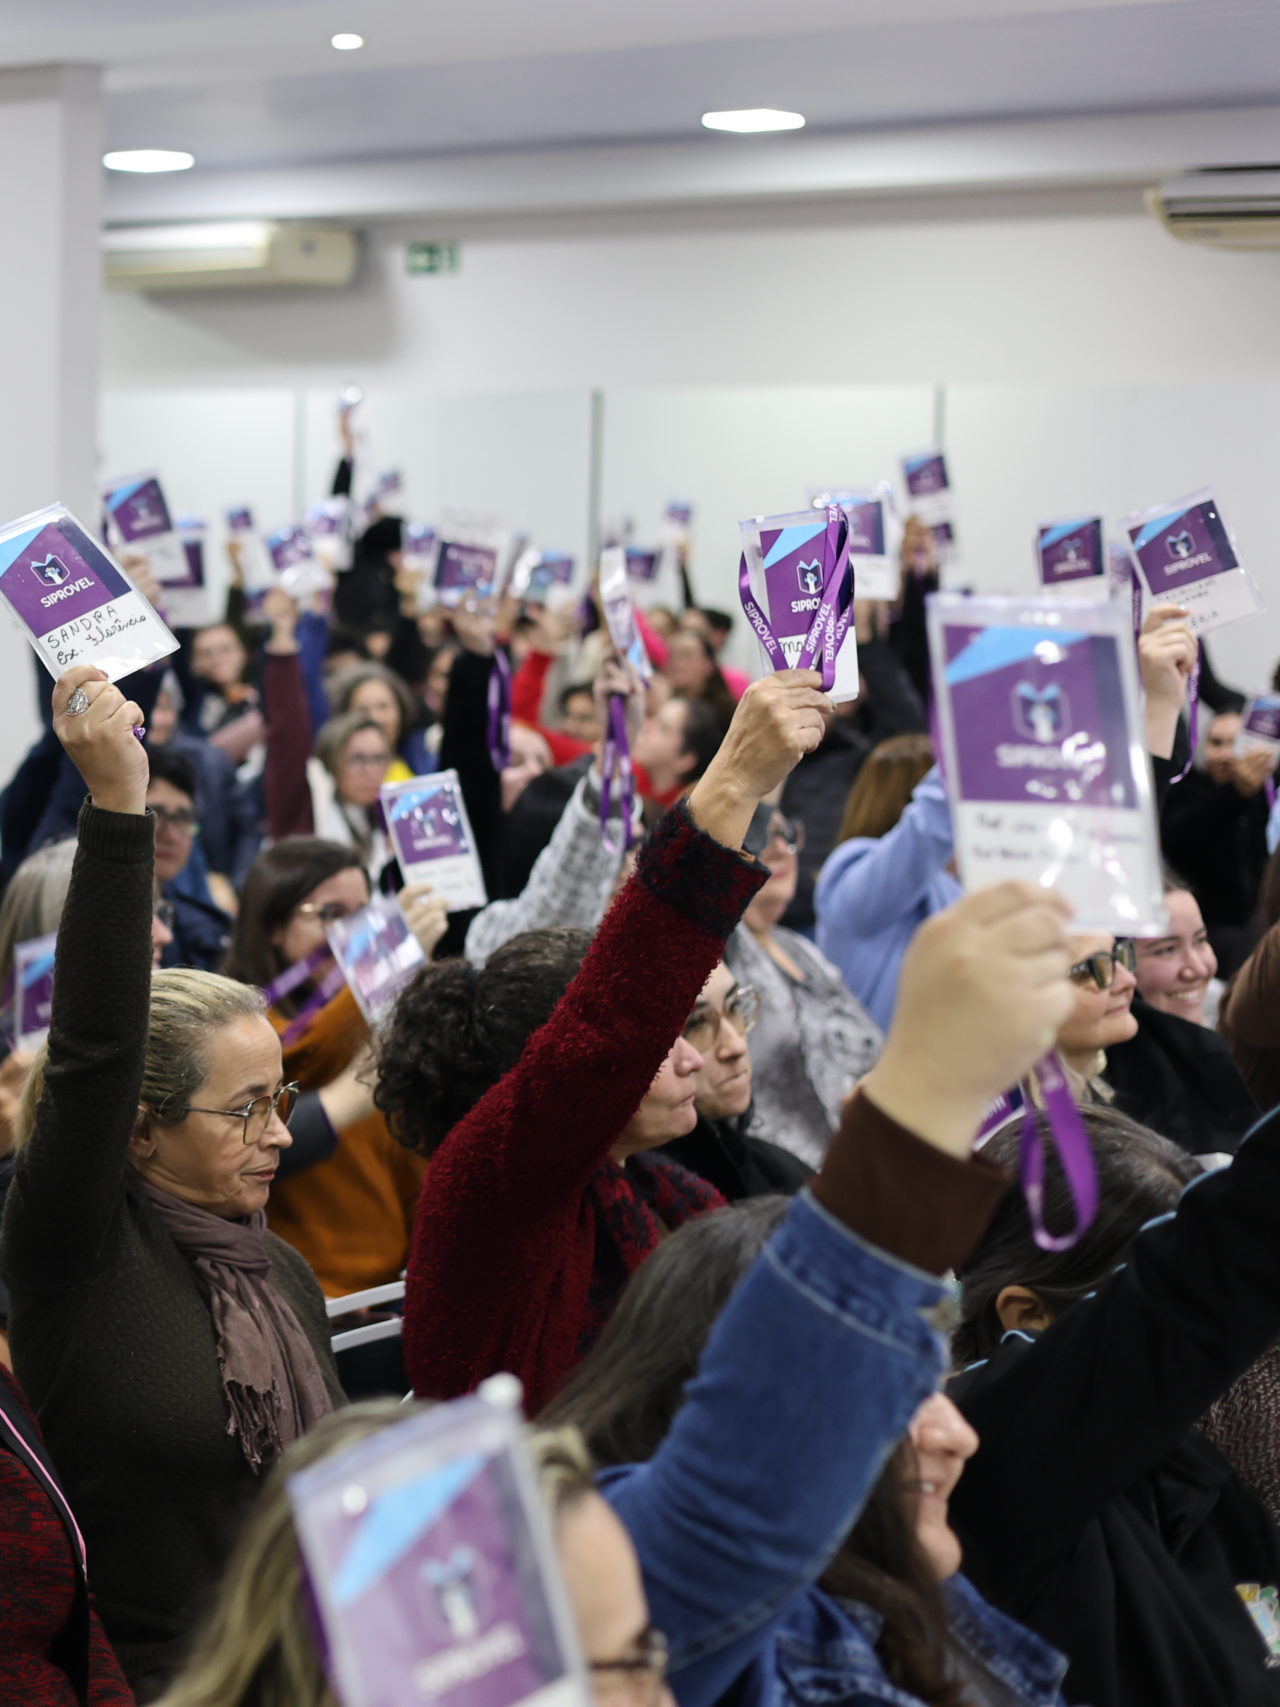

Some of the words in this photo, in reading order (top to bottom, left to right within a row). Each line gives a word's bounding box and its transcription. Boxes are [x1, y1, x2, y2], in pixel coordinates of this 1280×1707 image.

[40, 576, 95, 608] SIPROVEL
[791, 597, 821, 613] SIPRO
[47, 605, 117, 649] SANDRA
[744, 601, 776, 656] SIPROVEL
[805, 602, 832, 654] SIPROVEL
